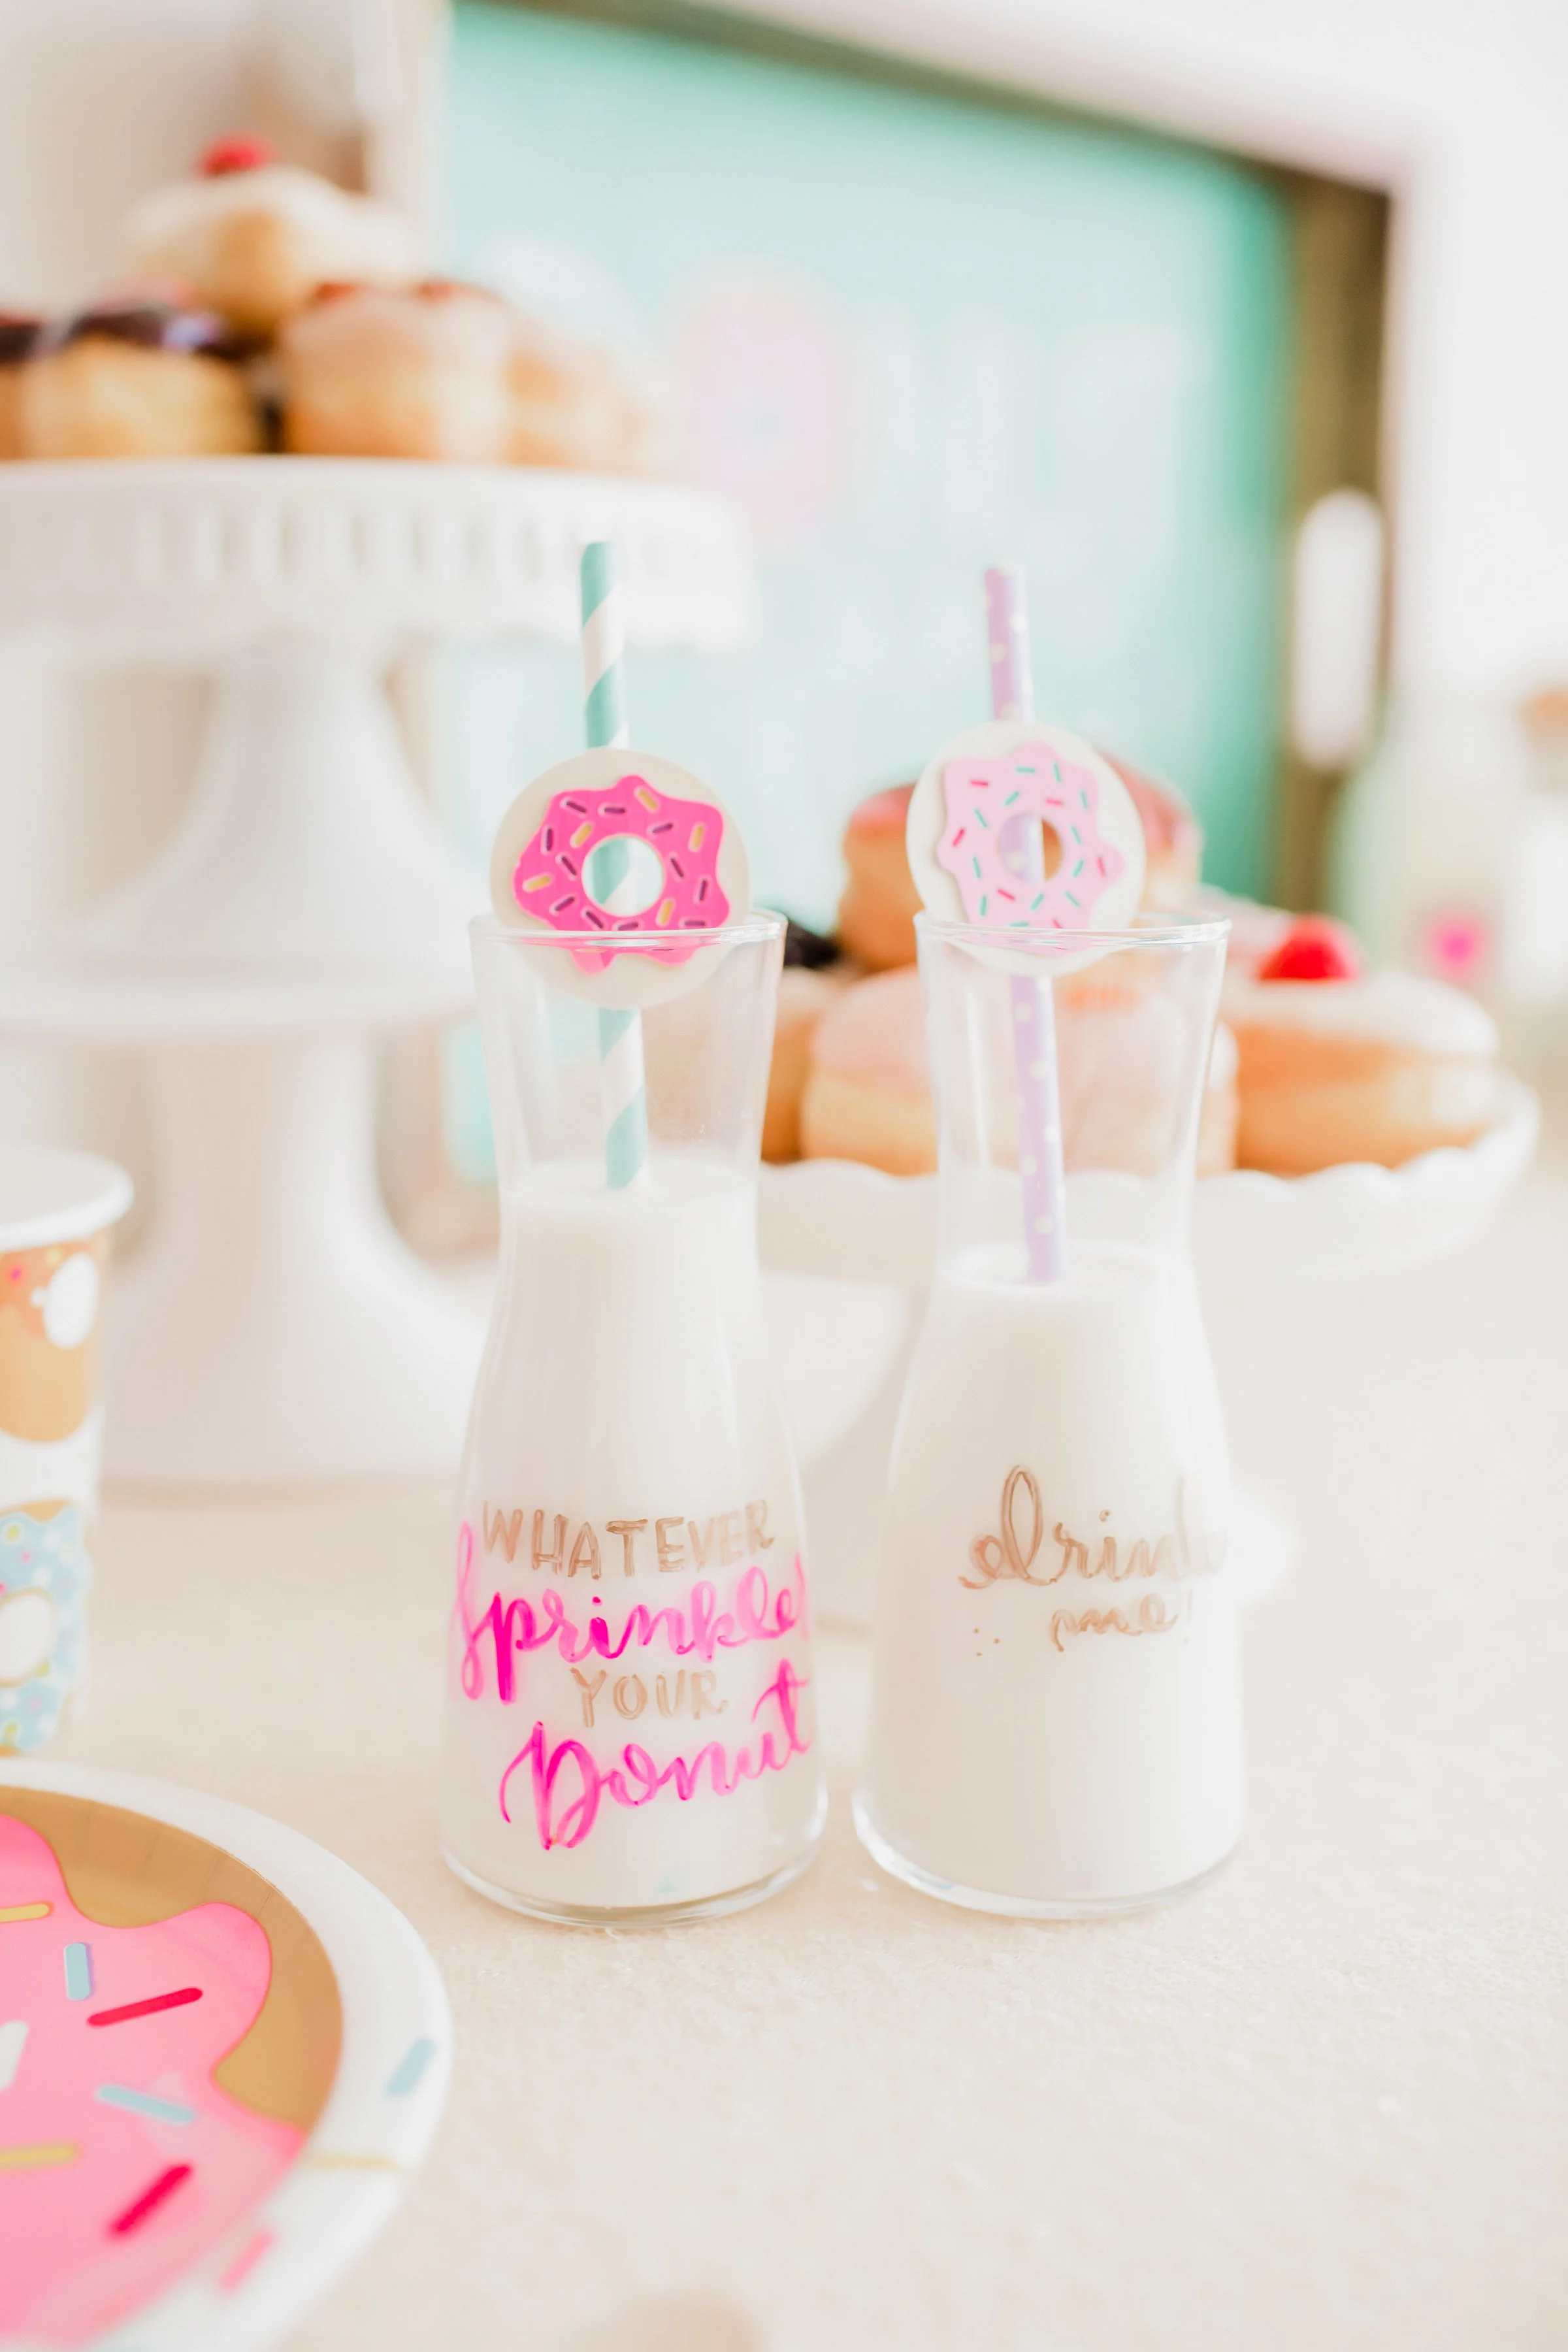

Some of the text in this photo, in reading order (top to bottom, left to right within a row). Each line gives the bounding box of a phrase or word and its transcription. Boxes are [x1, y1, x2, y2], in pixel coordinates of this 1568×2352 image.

[482, 1499, 775, 1580] WHATEVER
[570, 1666, 728, 1729] YOUR
[498, 1657, 812, 1851] Donut
